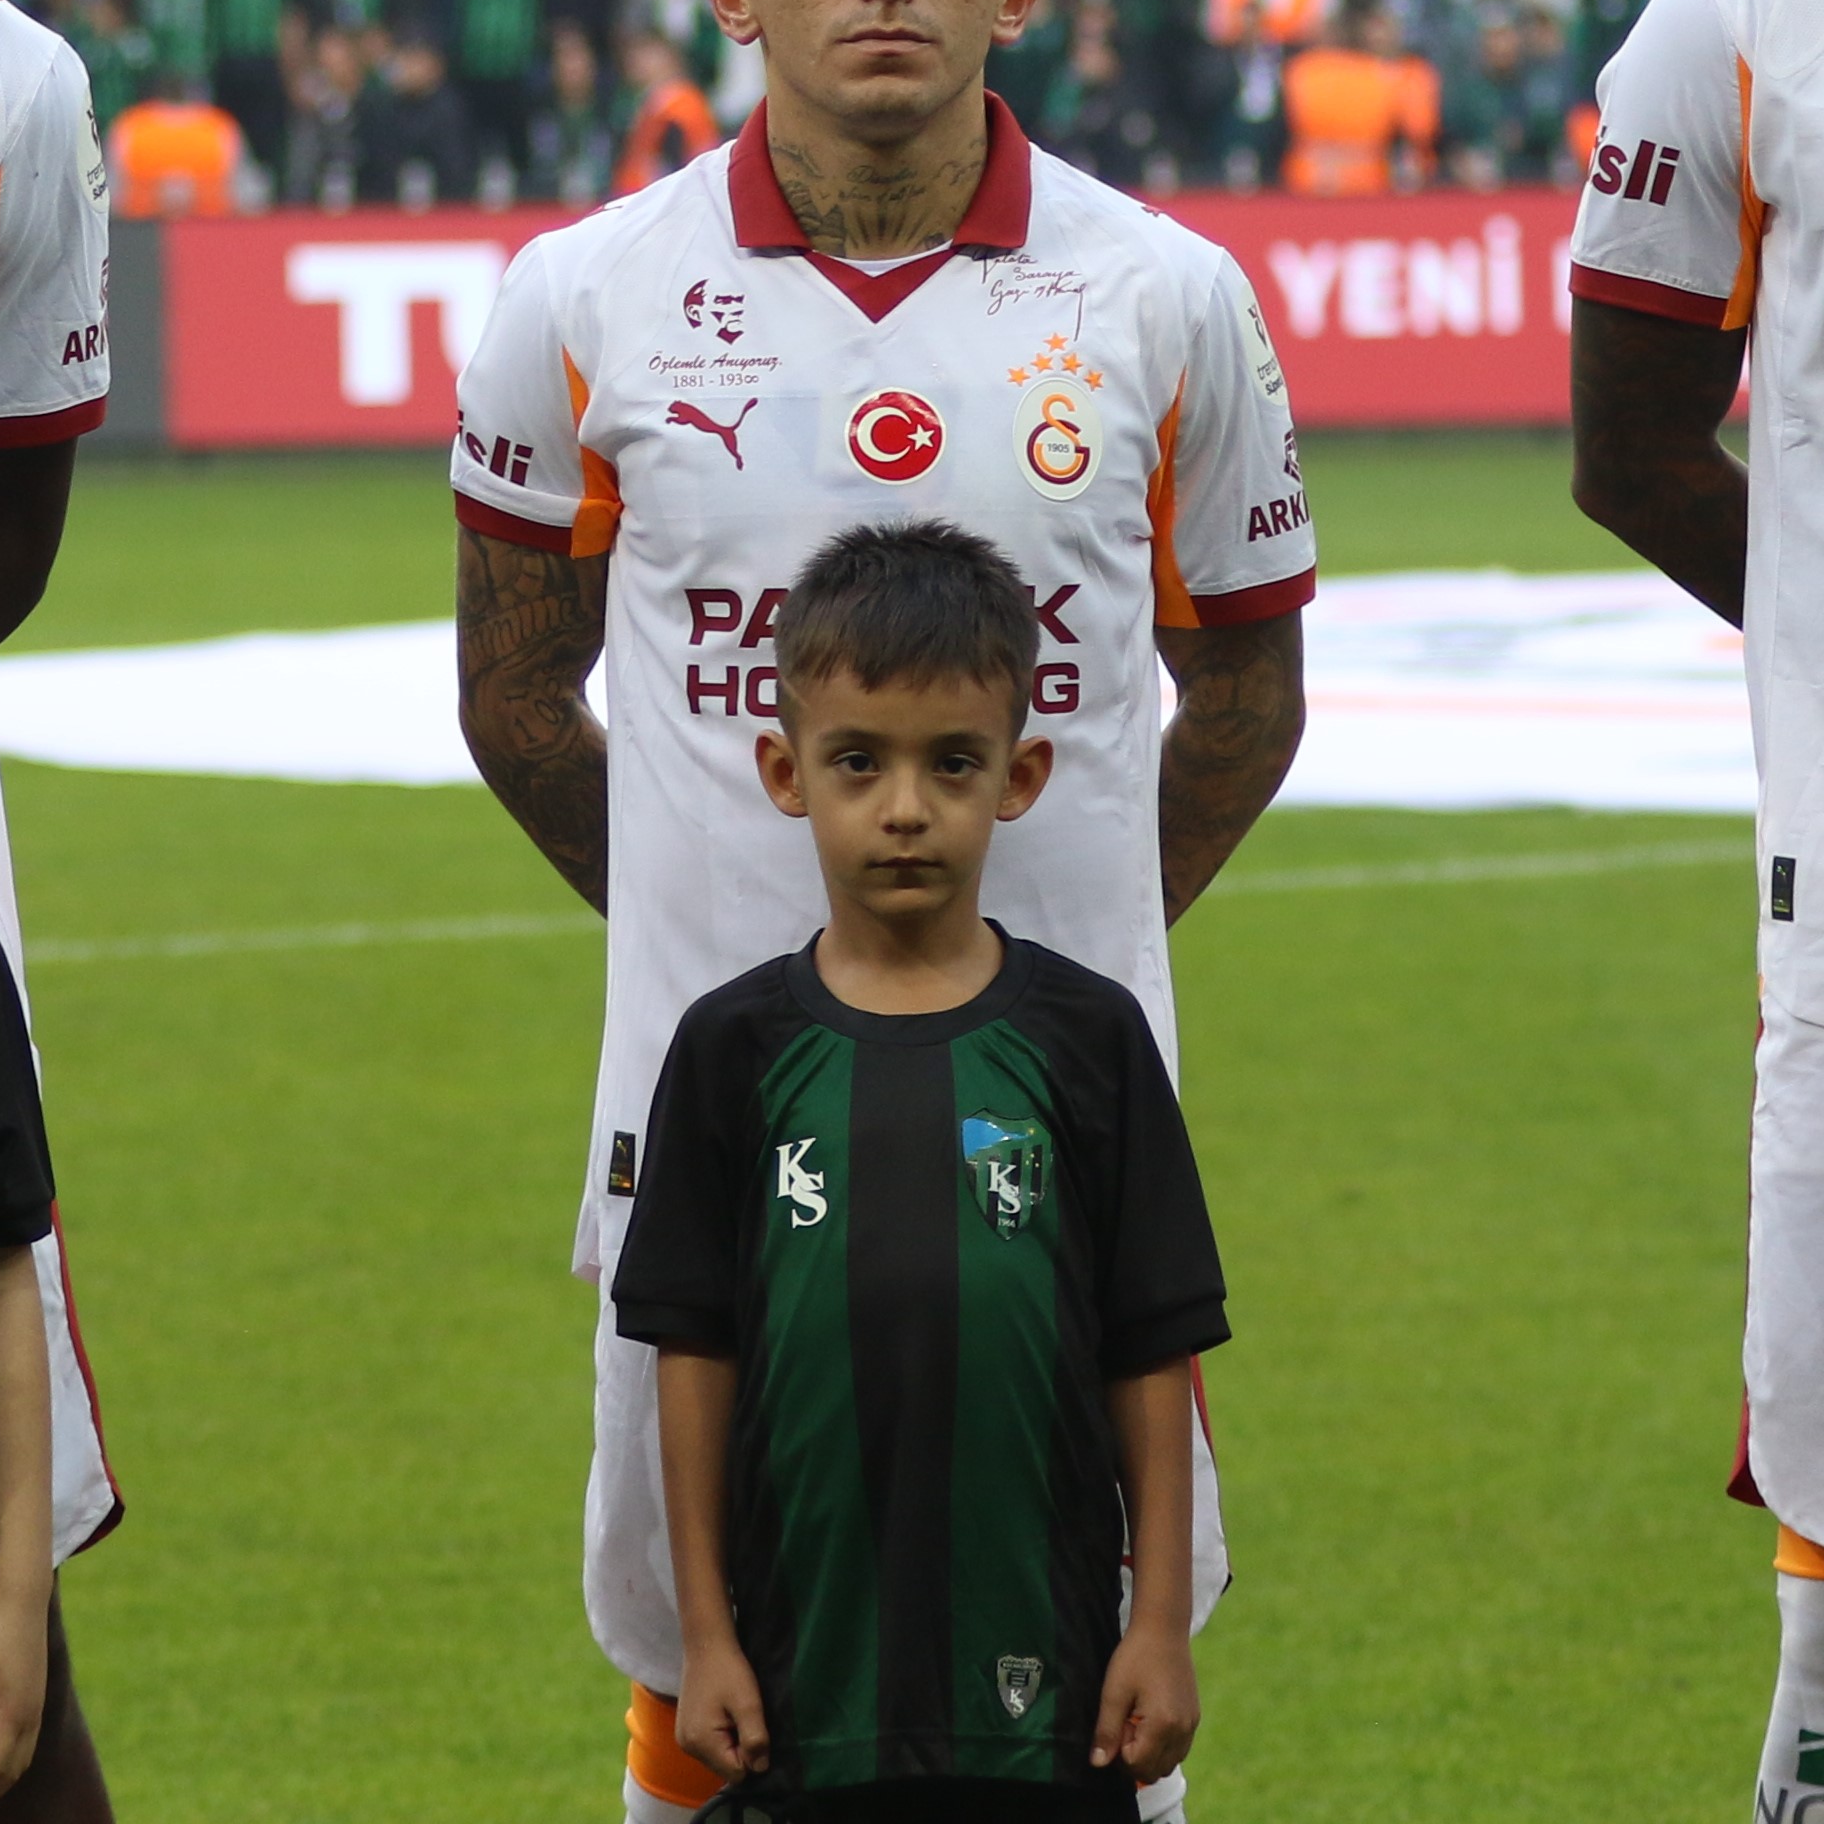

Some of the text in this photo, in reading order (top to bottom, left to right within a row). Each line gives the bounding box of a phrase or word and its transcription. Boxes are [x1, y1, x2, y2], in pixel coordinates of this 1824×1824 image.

[1588, 125, 1680, 207] sli
[1266, 215, 1525, 339] YENİ
[648, 350, 706, 375] Özlemle
[673, 375, 704, 389] 1881
[458, 408, 534, 488] sli
[1046, 442, 1071, 455] 1905
